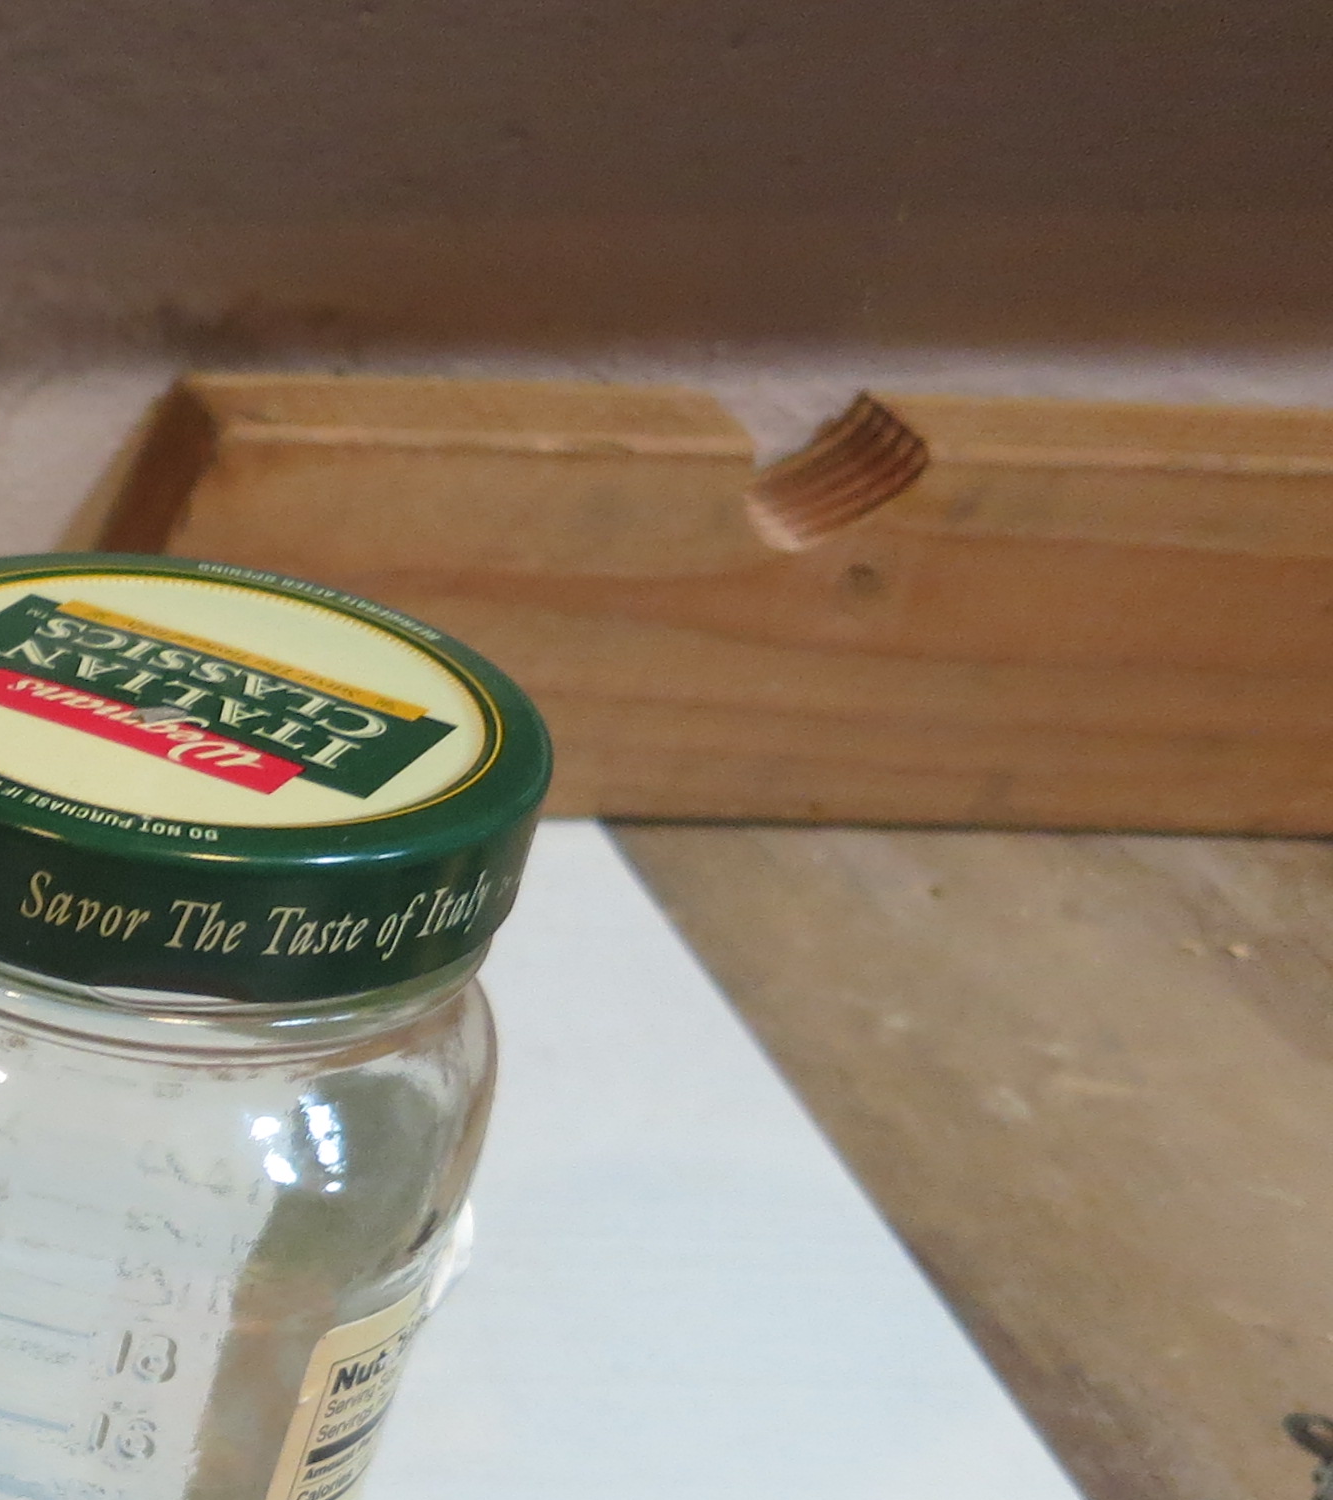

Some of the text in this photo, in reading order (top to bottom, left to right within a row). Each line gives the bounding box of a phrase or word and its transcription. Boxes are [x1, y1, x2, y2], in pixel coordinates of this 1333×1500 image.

[33, 617, 388, 739] CLASSICS
[3, 787, 24, 799] IF
[23, 794, 133, 831] PURCHASE
[139, 822, 182, 837] NOT
[189, 828, 220, 842] DO
[20, 870, 150, 942] Savor
[163, 899, 246, 956] The
[261, 905, 367, 957] Taste
[375, 898, 425, 962] of
[415, 869, 491, 939] Italy
